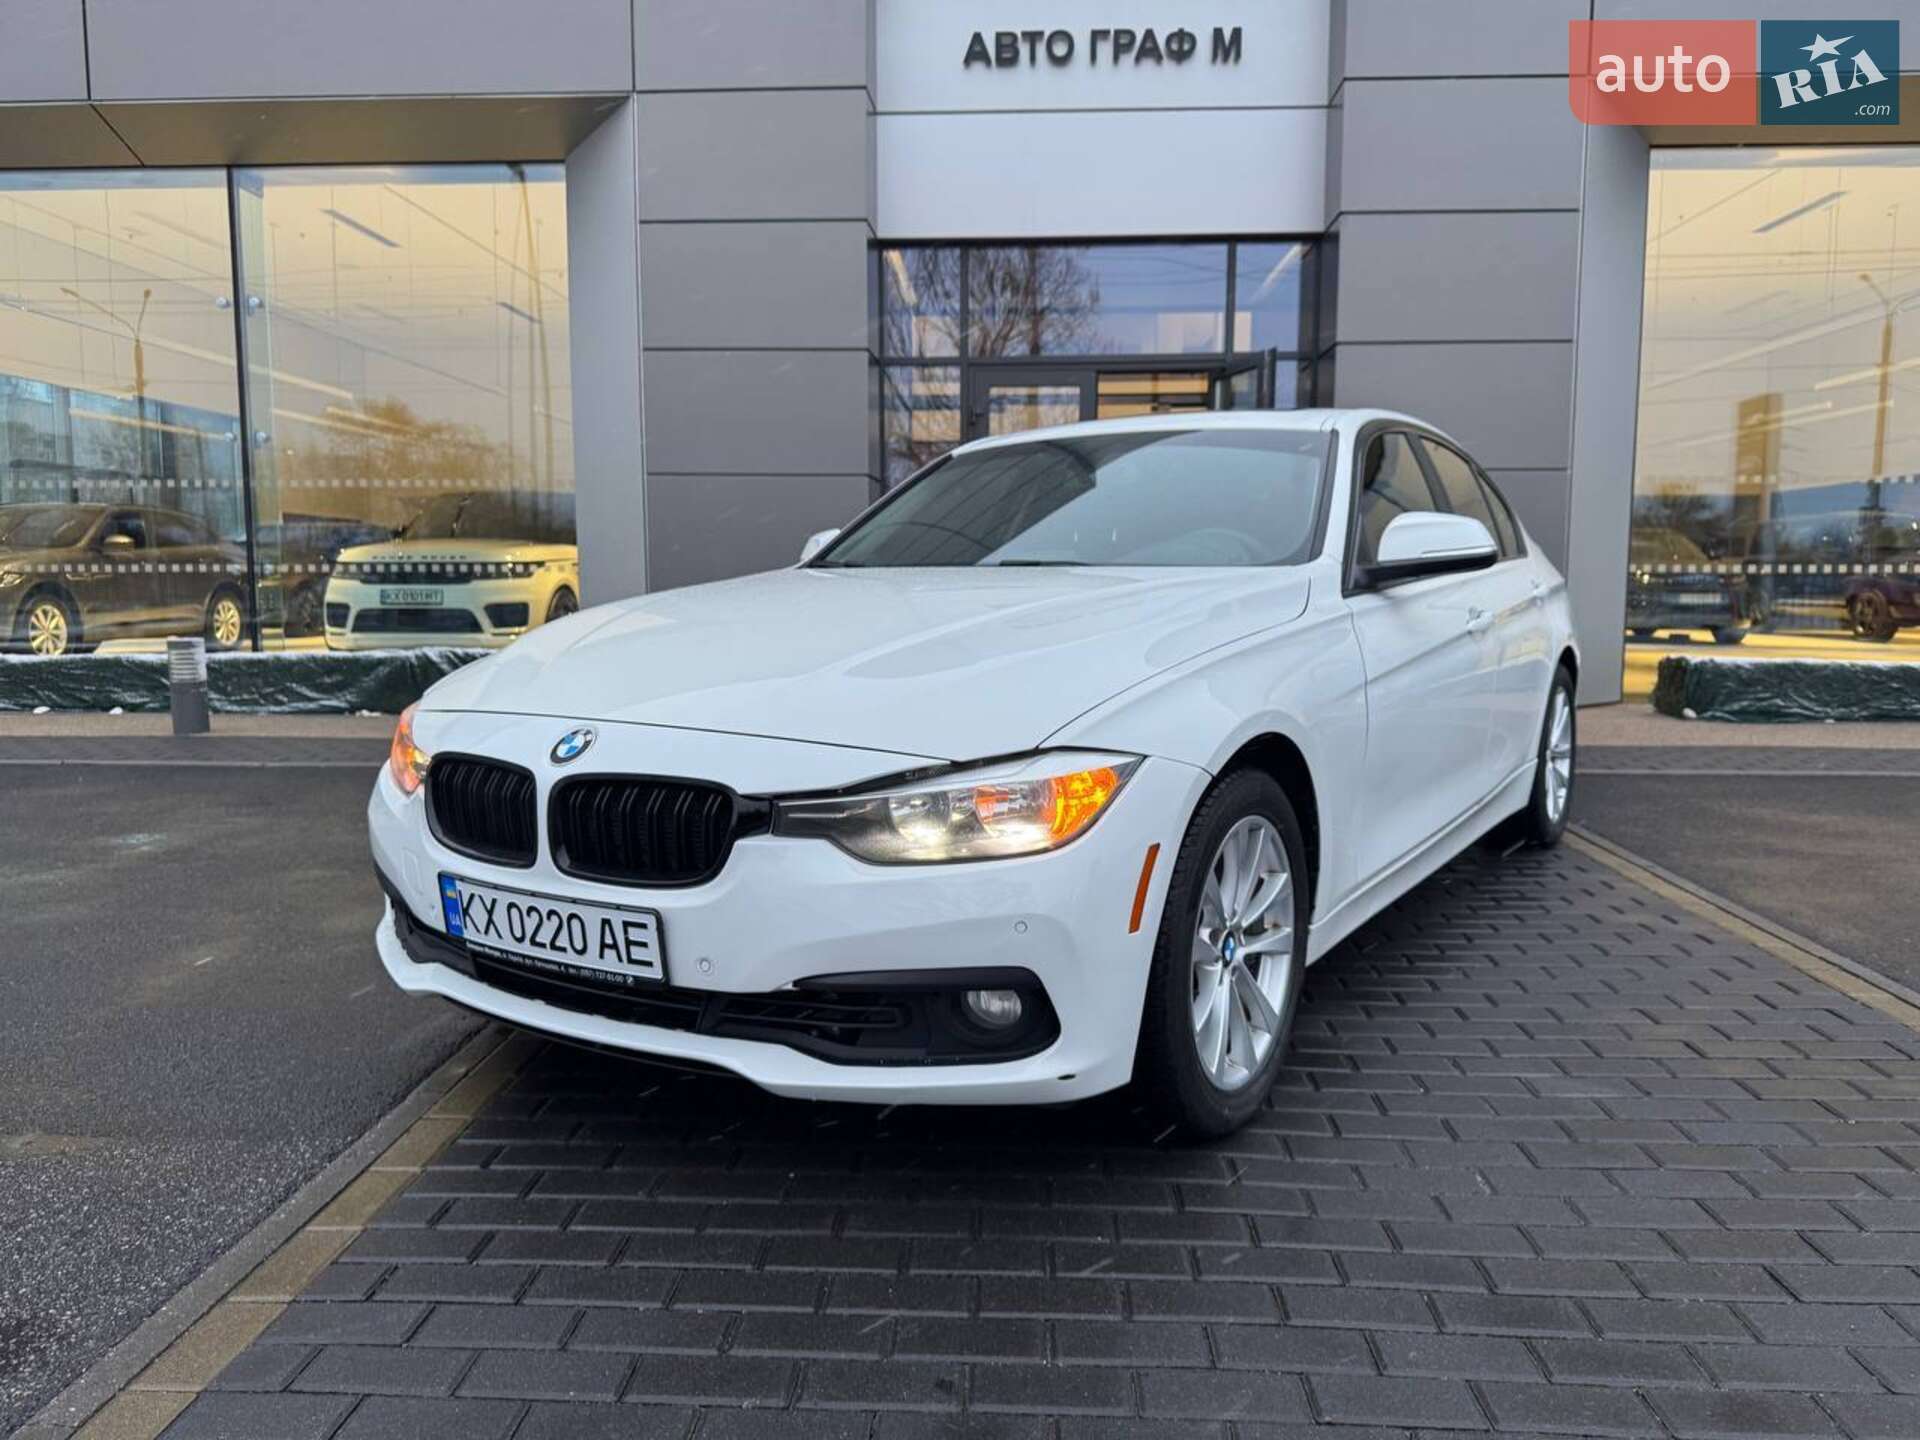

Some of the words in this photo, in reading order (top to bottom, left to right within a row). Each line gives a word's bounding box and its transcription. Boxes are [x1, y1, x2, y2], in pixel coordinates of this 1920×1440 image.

[963, 30, 1075, 68] АВТО
[1090, 28, 1198, 66] ГРАФ
[1211, 27, 1243, 65] М
[458, 889, 503, 939] KX
[506, 901, 588, 956] 0220
[599, 918, 654, 968] AE
